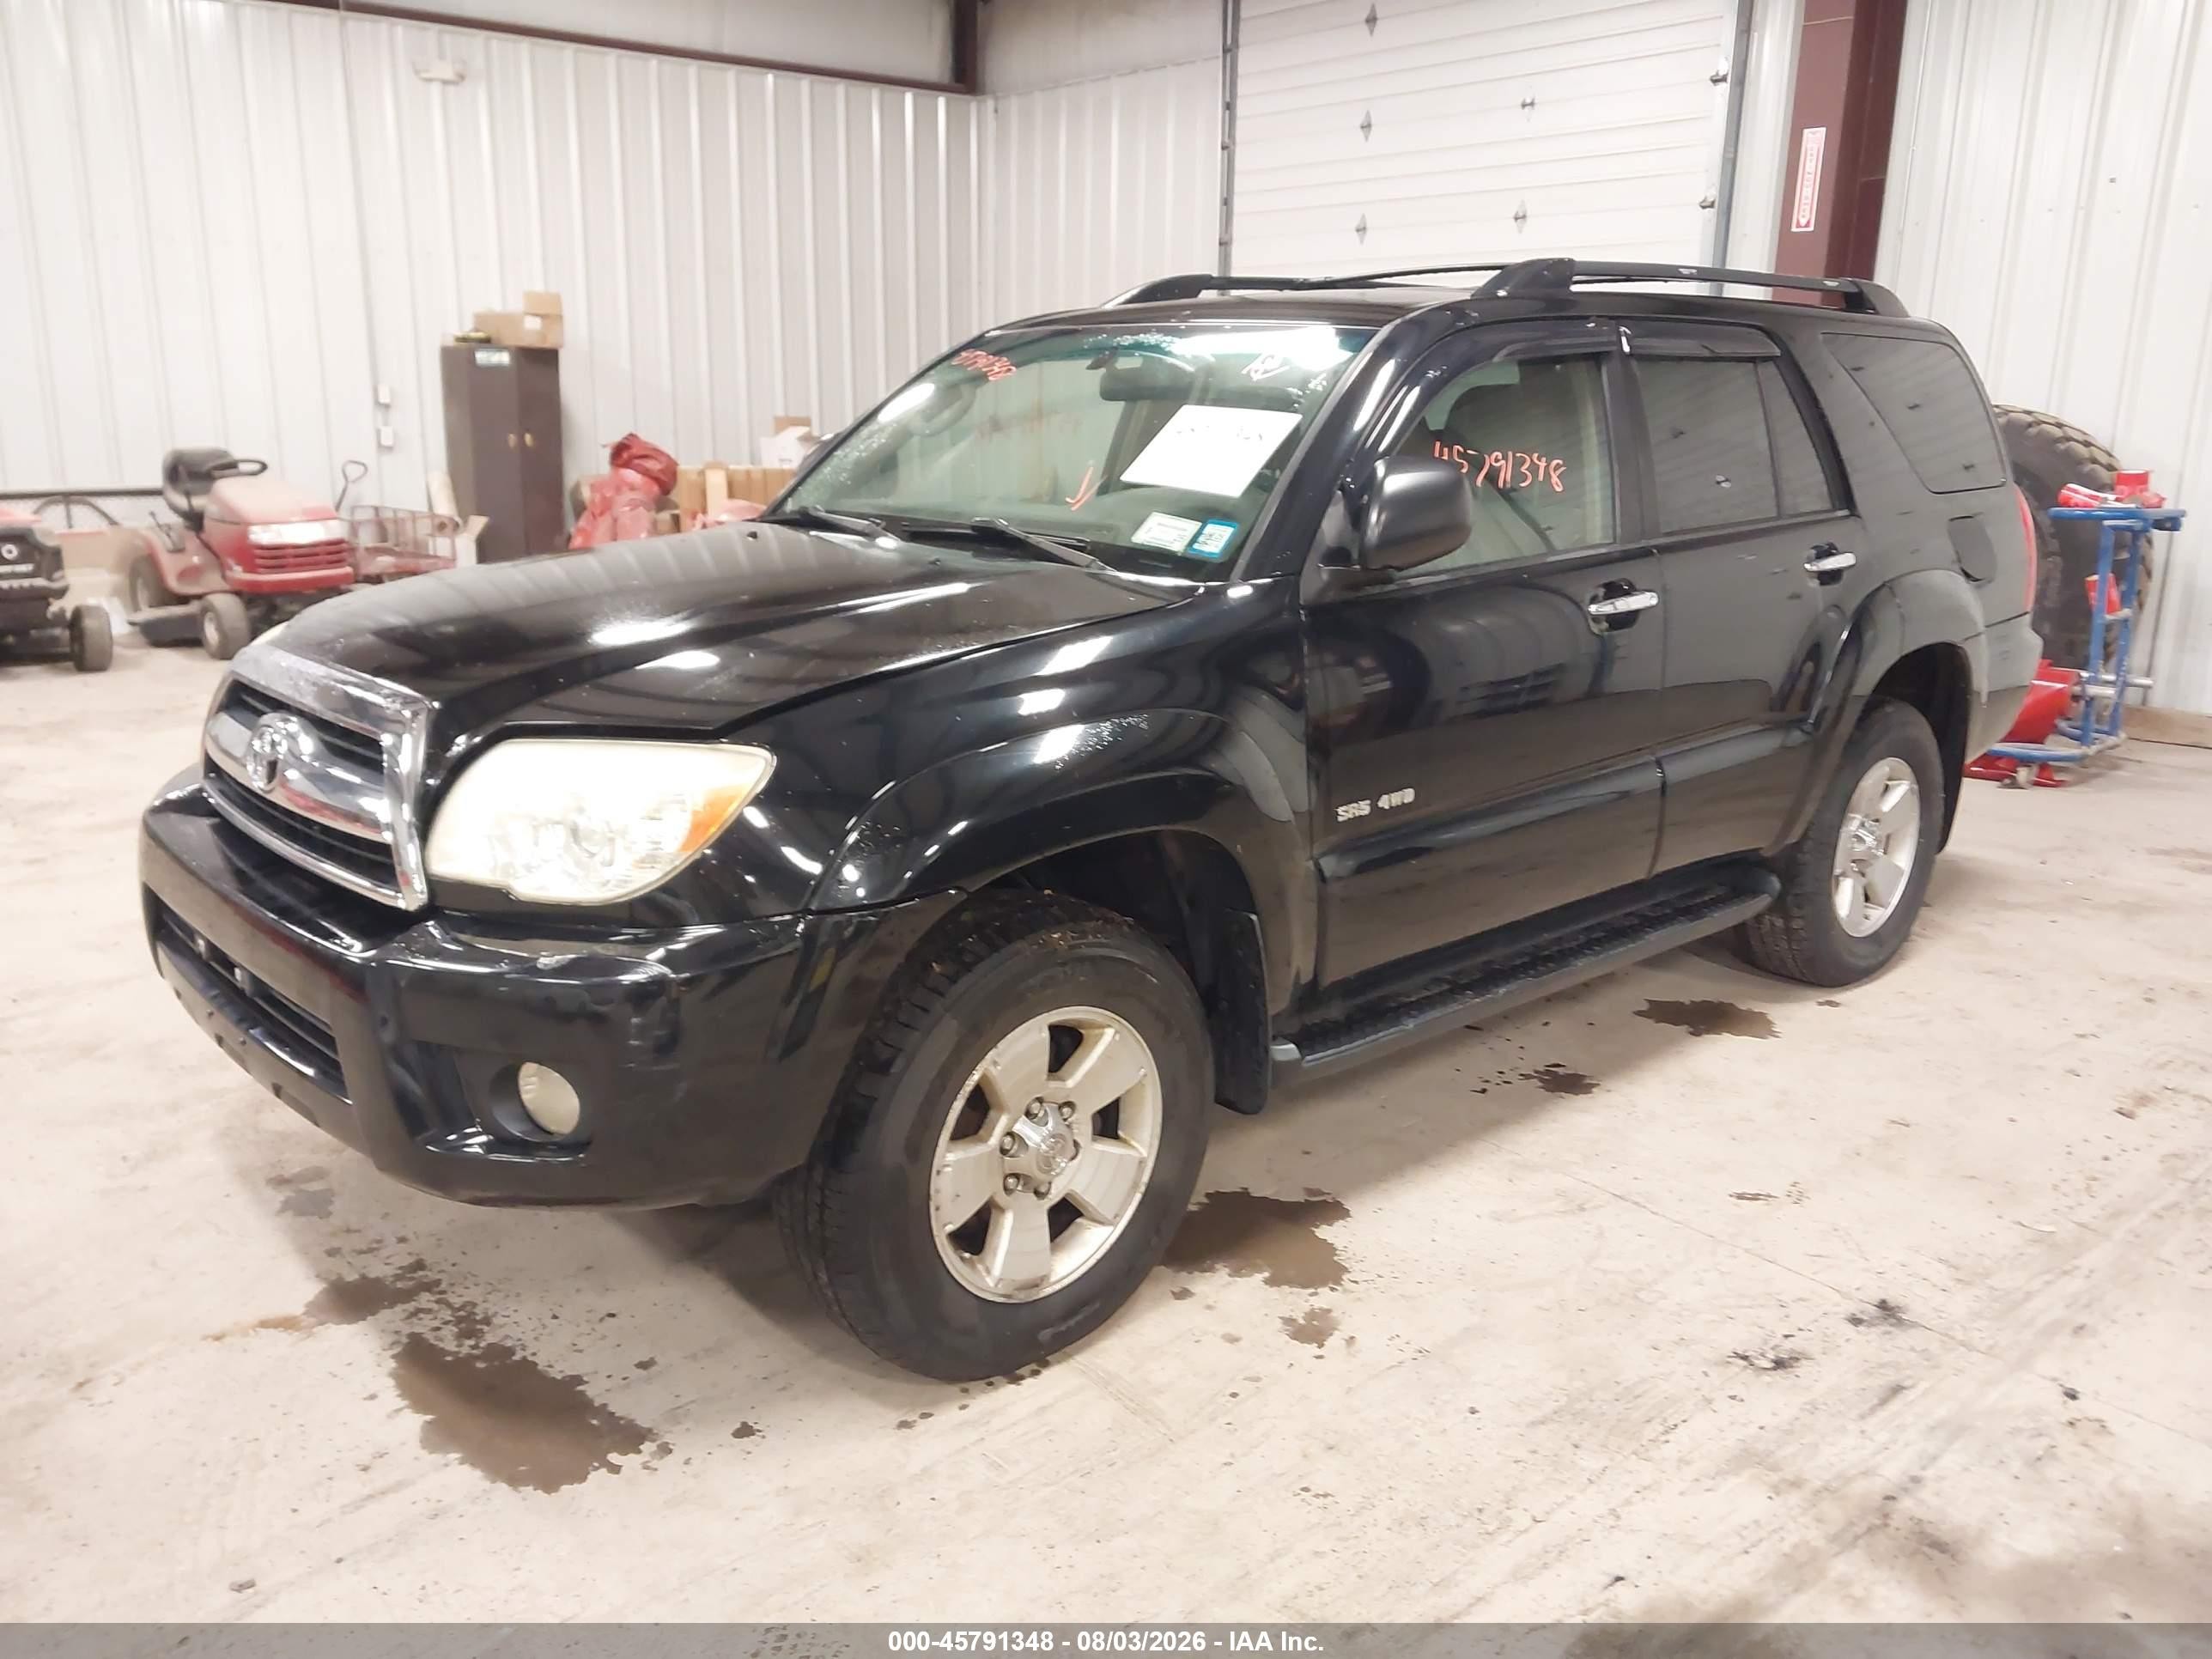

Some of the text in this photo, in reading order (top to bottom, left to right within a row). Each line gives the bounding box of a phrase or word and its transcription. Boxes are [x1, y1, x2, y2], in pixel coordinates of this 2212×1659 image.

[1432, 440, 1567, 493] 45791348
[1334, 787, 1416, 823] SR5 4WD
